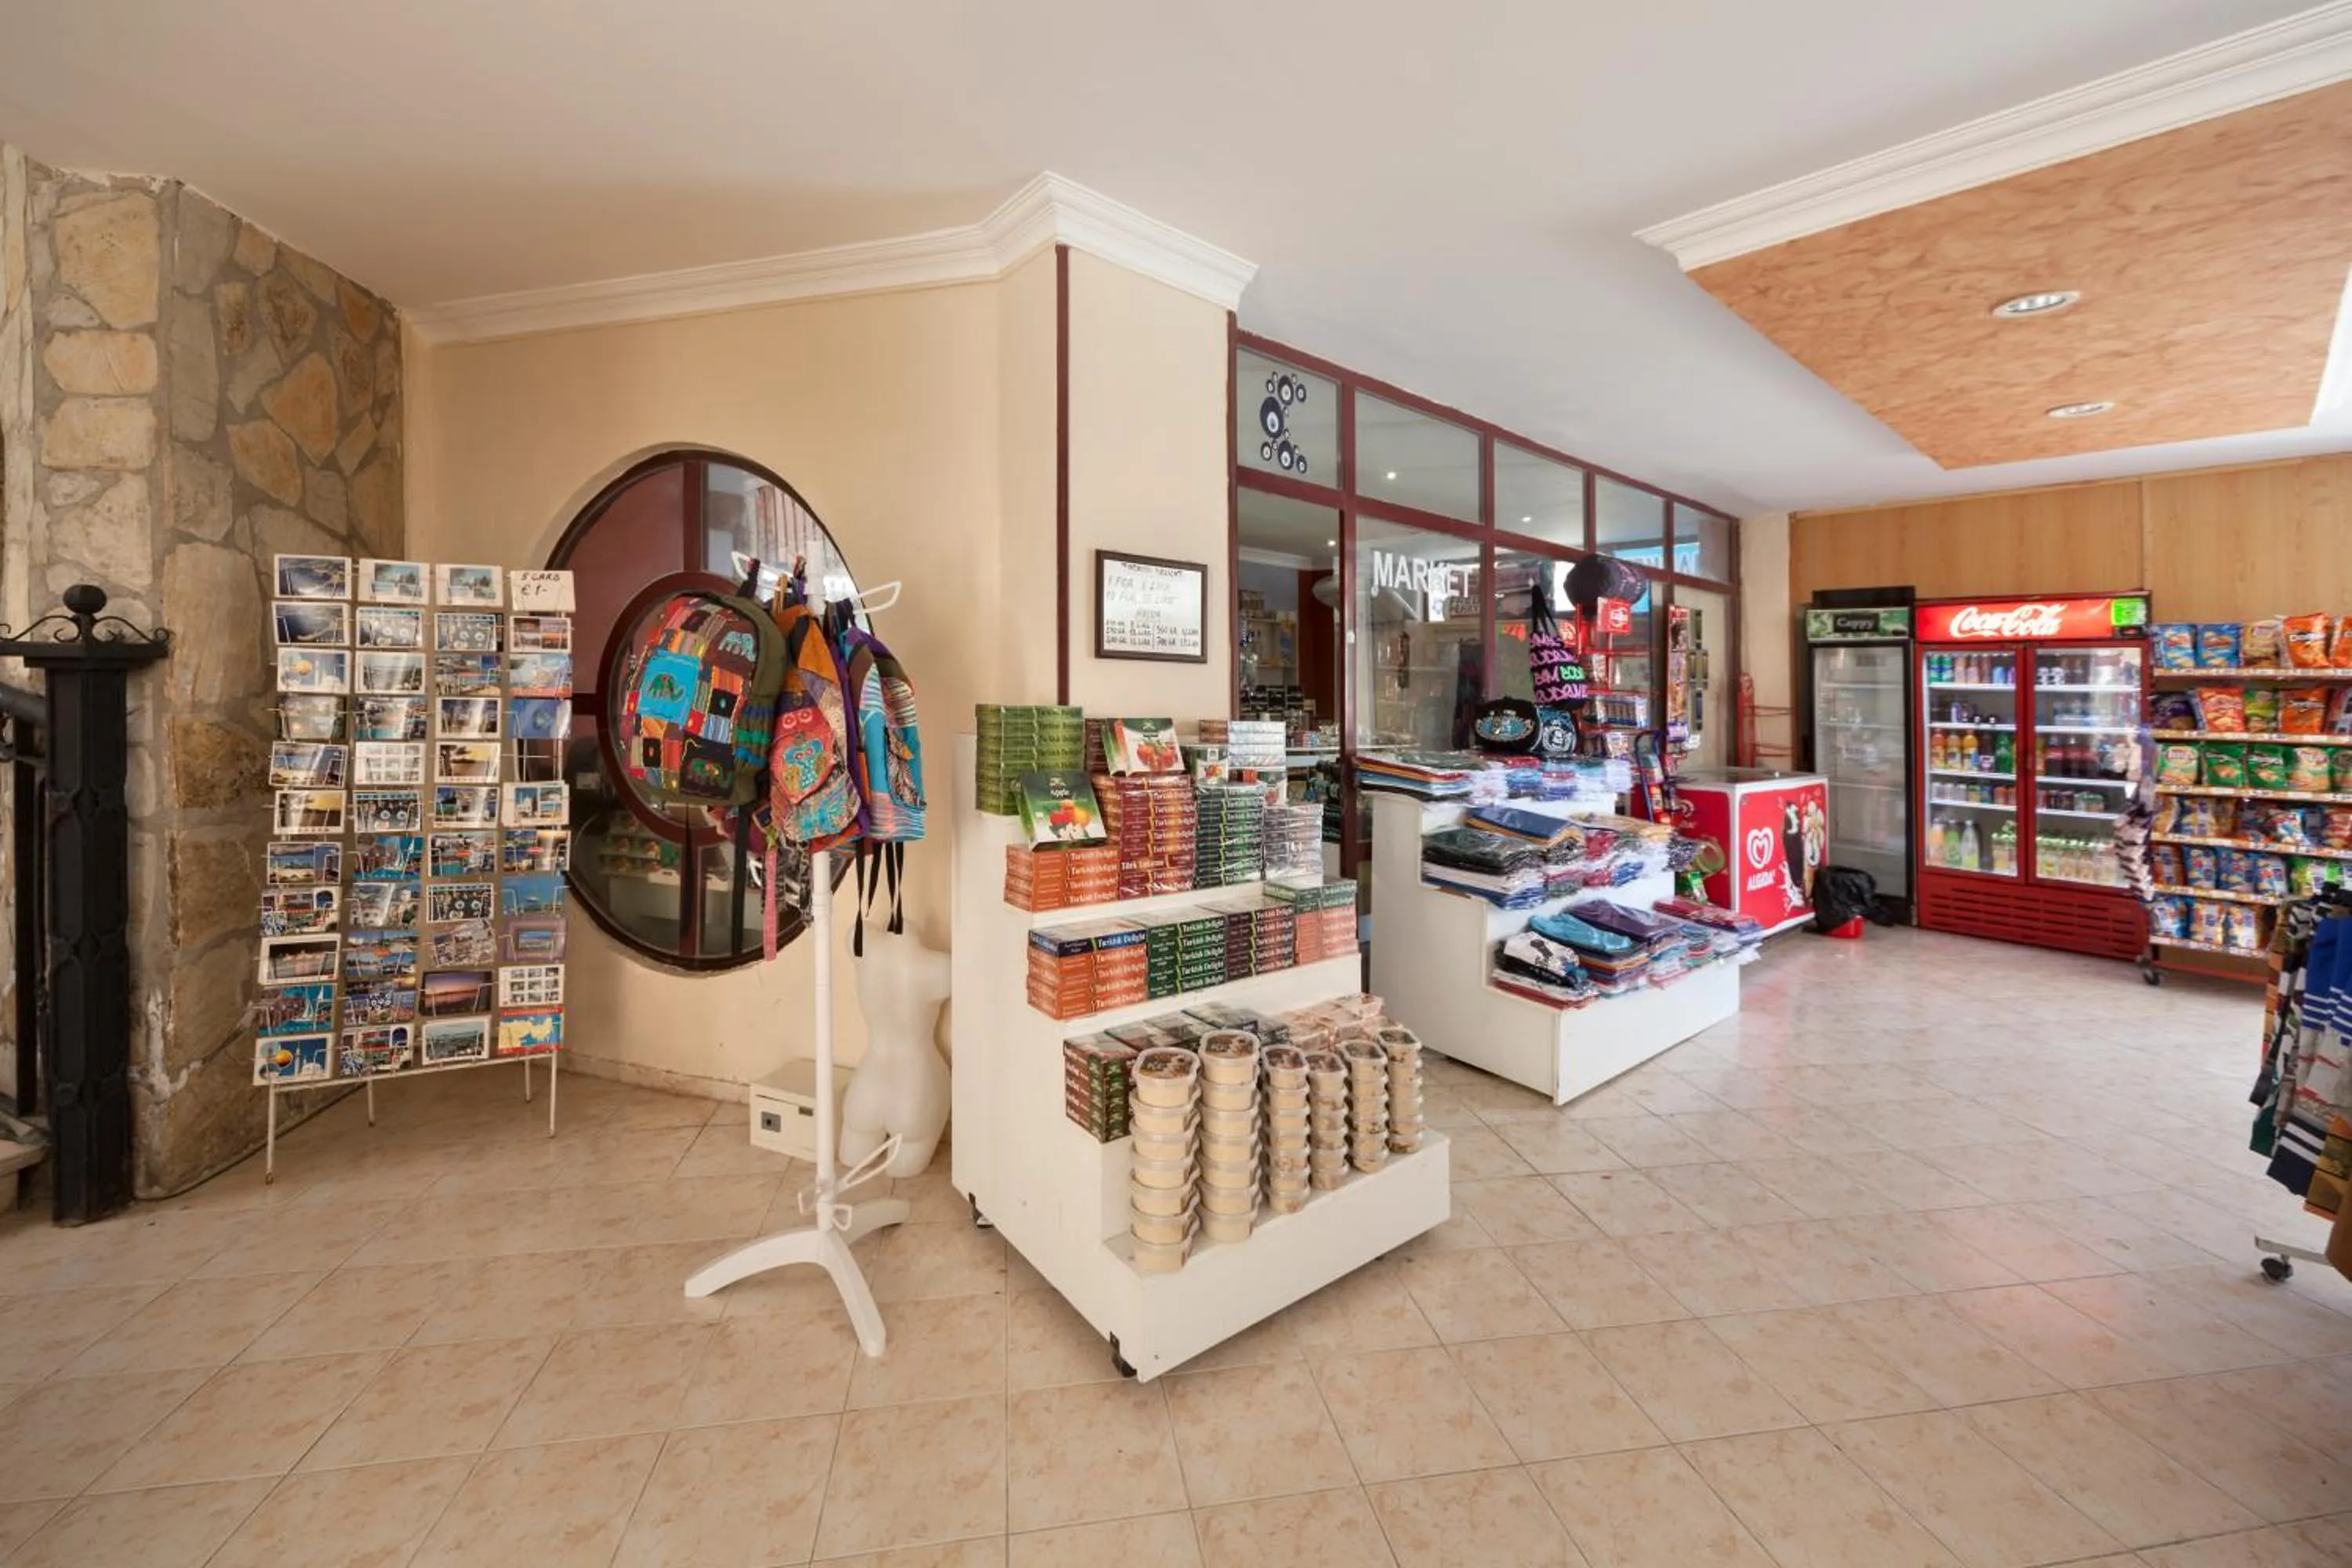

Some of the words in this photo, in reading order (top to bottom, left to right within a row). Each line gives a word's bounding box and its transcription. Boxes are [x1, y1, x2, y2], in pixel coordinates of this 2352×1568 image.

[1374, 550, 1473, 598] MARKET
[1837, 617, 1875, 630] Cappy
[1951, 604, 2068, 638] Coca-Cola
[1181, 923, 1203, 934] Turkish
[1204, 919, 1224, 930] Delight
[1098, 937, 1121, 949] Turkish
[1123, 932, 1145, 944] Delight
[1182, 937, 1203, 948] Turkish
[1204, 933, 1224, 944] Delight
[1181, 964, 1203, 975] Turkish
[1204, 960, 1224, 972] Delight
